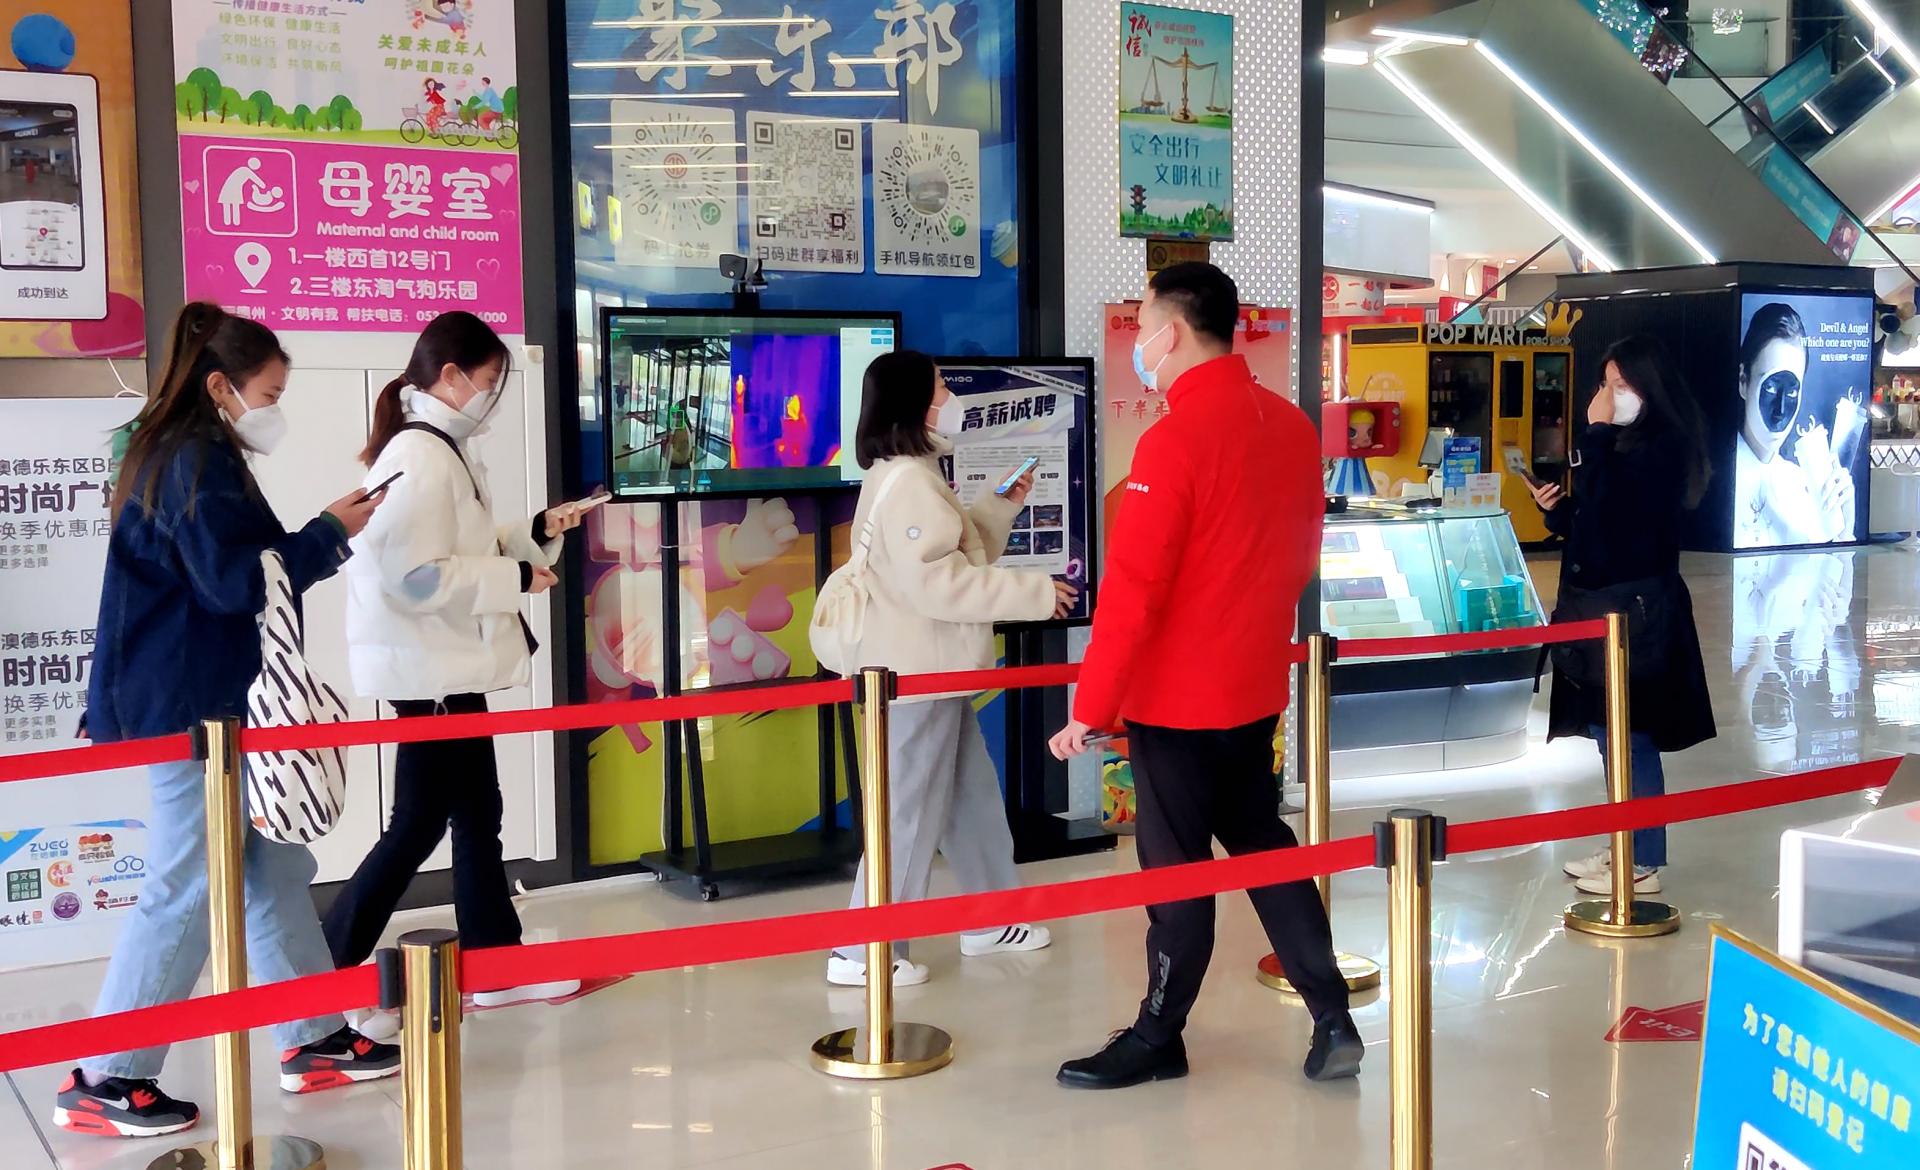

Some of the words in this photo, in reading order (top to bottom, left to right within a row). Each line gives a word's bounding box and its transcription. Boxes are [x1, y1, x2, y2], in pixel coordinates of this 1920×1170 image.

[285, 18, 341, 34] 健康生活
[221, 33, 276, 48] 文明出行
[378, 34, 487, 57] 关爱未成年人
[384, 57, 474, 75] 呵护祖国花朵
[1129, 133, 1200, 159] 安全出行
[1155, 163, 1222, 188] 文明礼让
[318, 161, 493, 220] 母婴室
[317, 221, 386, 238] Maternal
[390, 223, 420, 239] and
[423, 223, 457, 240] child
[461, 229, 499, 242] room
[288, 247, 451, 271] 1.一楼西首12号门
[756, 246, 859, 265] 扫码进群享福利
[880, 250, 976, 269] 手机导航领红包
[17, 287, 69, 300] 成功到达
[289, 276, 478, 300] 2.三楼东淘气狗乐园
[1427, 323, 1467, 345] POP
[1473, 325, 1527, 345] MART
[1820, 322, 1840, 333] Devil
[1848, 322, 1869, 336] Angel
[1800, 336, 1824, 348] Which
[1825, 339, 1840, 348] one
[1840, 339, 1852, 348] are
[1852, 337, 1870, 350] you?
[961, 393, 1057, 432] 高薪诚聘
[1111, 400, 1169, 420] 下半年
[0, 518, 111, 540] 换季优惠店
[0, 543, 48, 555] 更多实惠
[0, 556, 48, 569] 更多选择
[1, 628, 97, 650] 澳德乐东区
[4, 689, 88, 714] 换季优惠
[5, 715, 56, 729] 更多实惠
[6, 727, 57, 741] 更多选择
[1639, 1018, 1696, 1037] Exit
